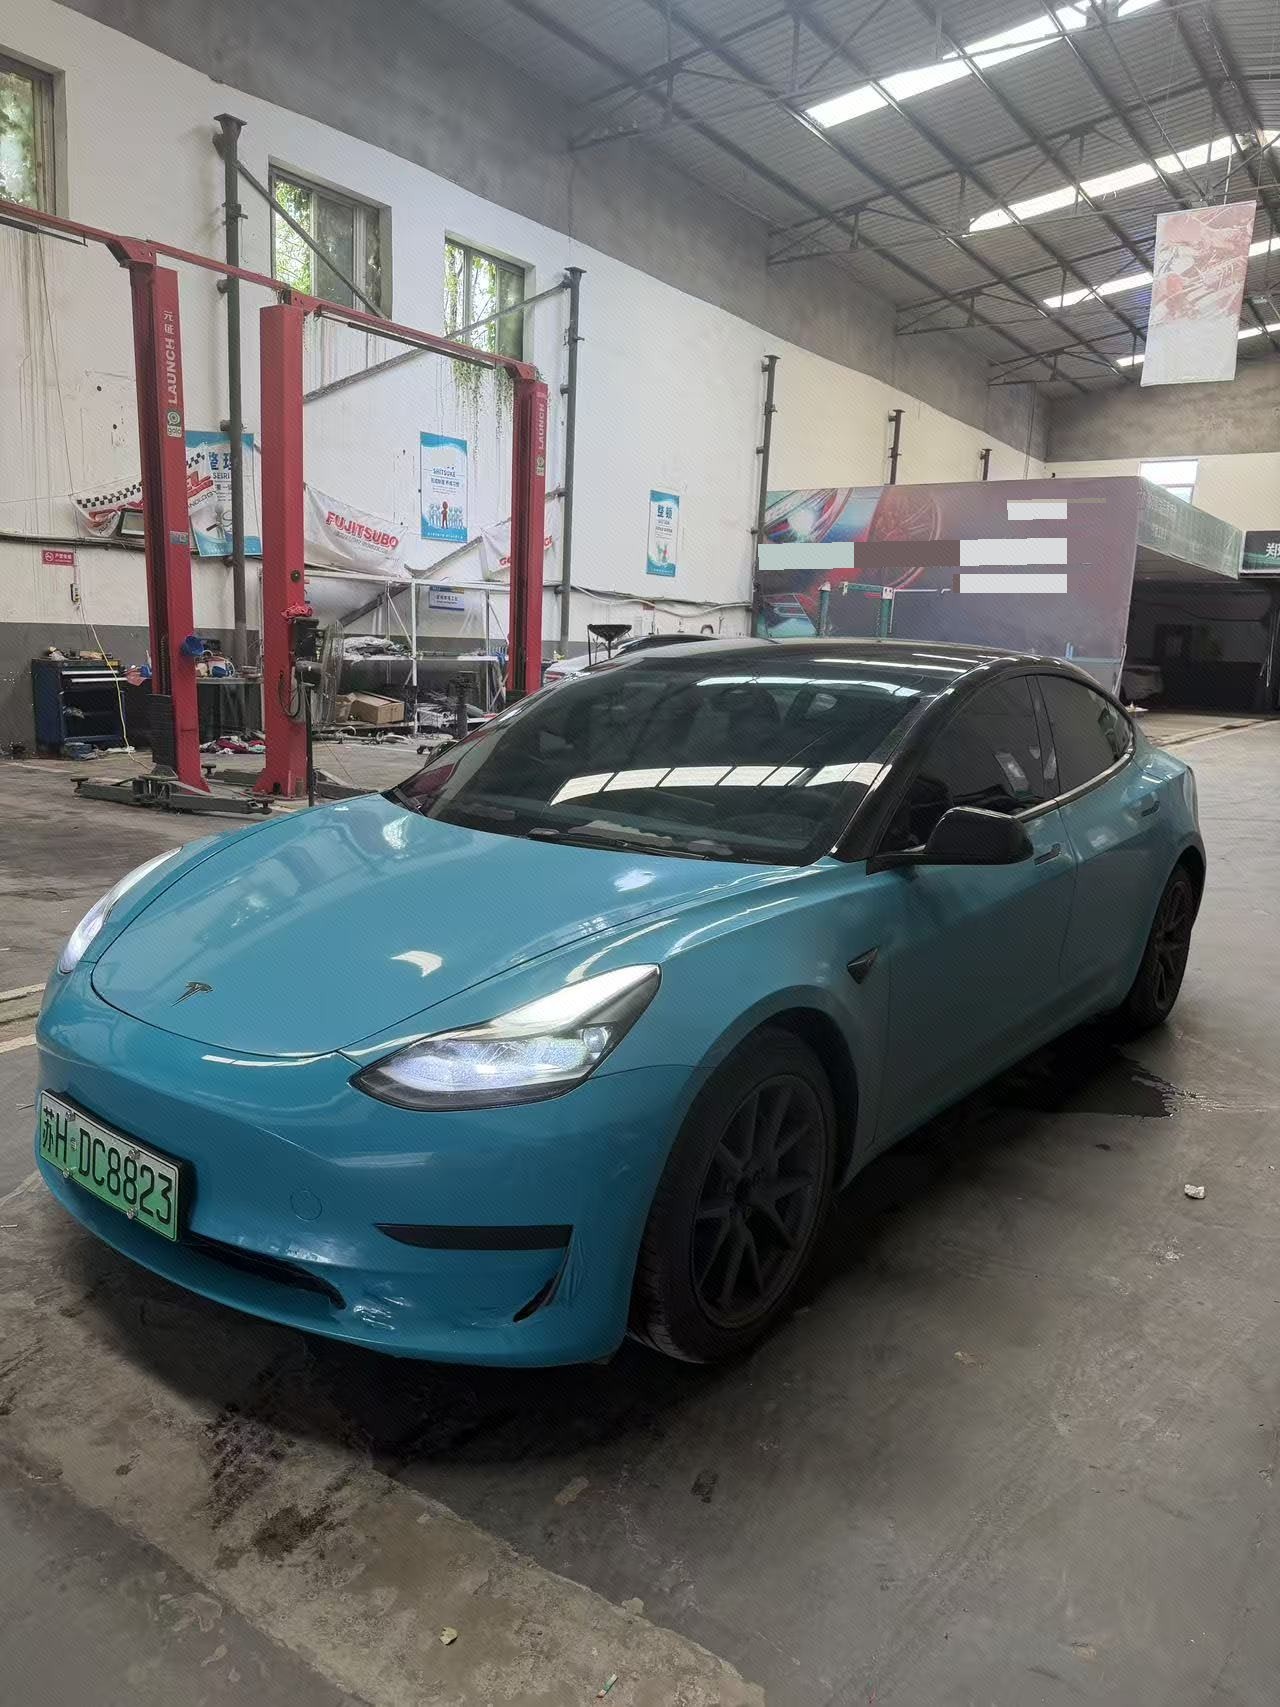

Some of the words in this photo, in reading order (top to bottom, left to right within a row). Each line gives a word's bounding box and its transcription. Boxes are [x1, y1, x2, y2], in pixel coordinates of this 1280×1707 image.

[165, 338, 178, 405] LAUNCH
[538, 403, 546, 449] LAUNCH
[213, 472, 230, 480] SEIRI
[326, 511, 399, 549] FUJITSUBO
